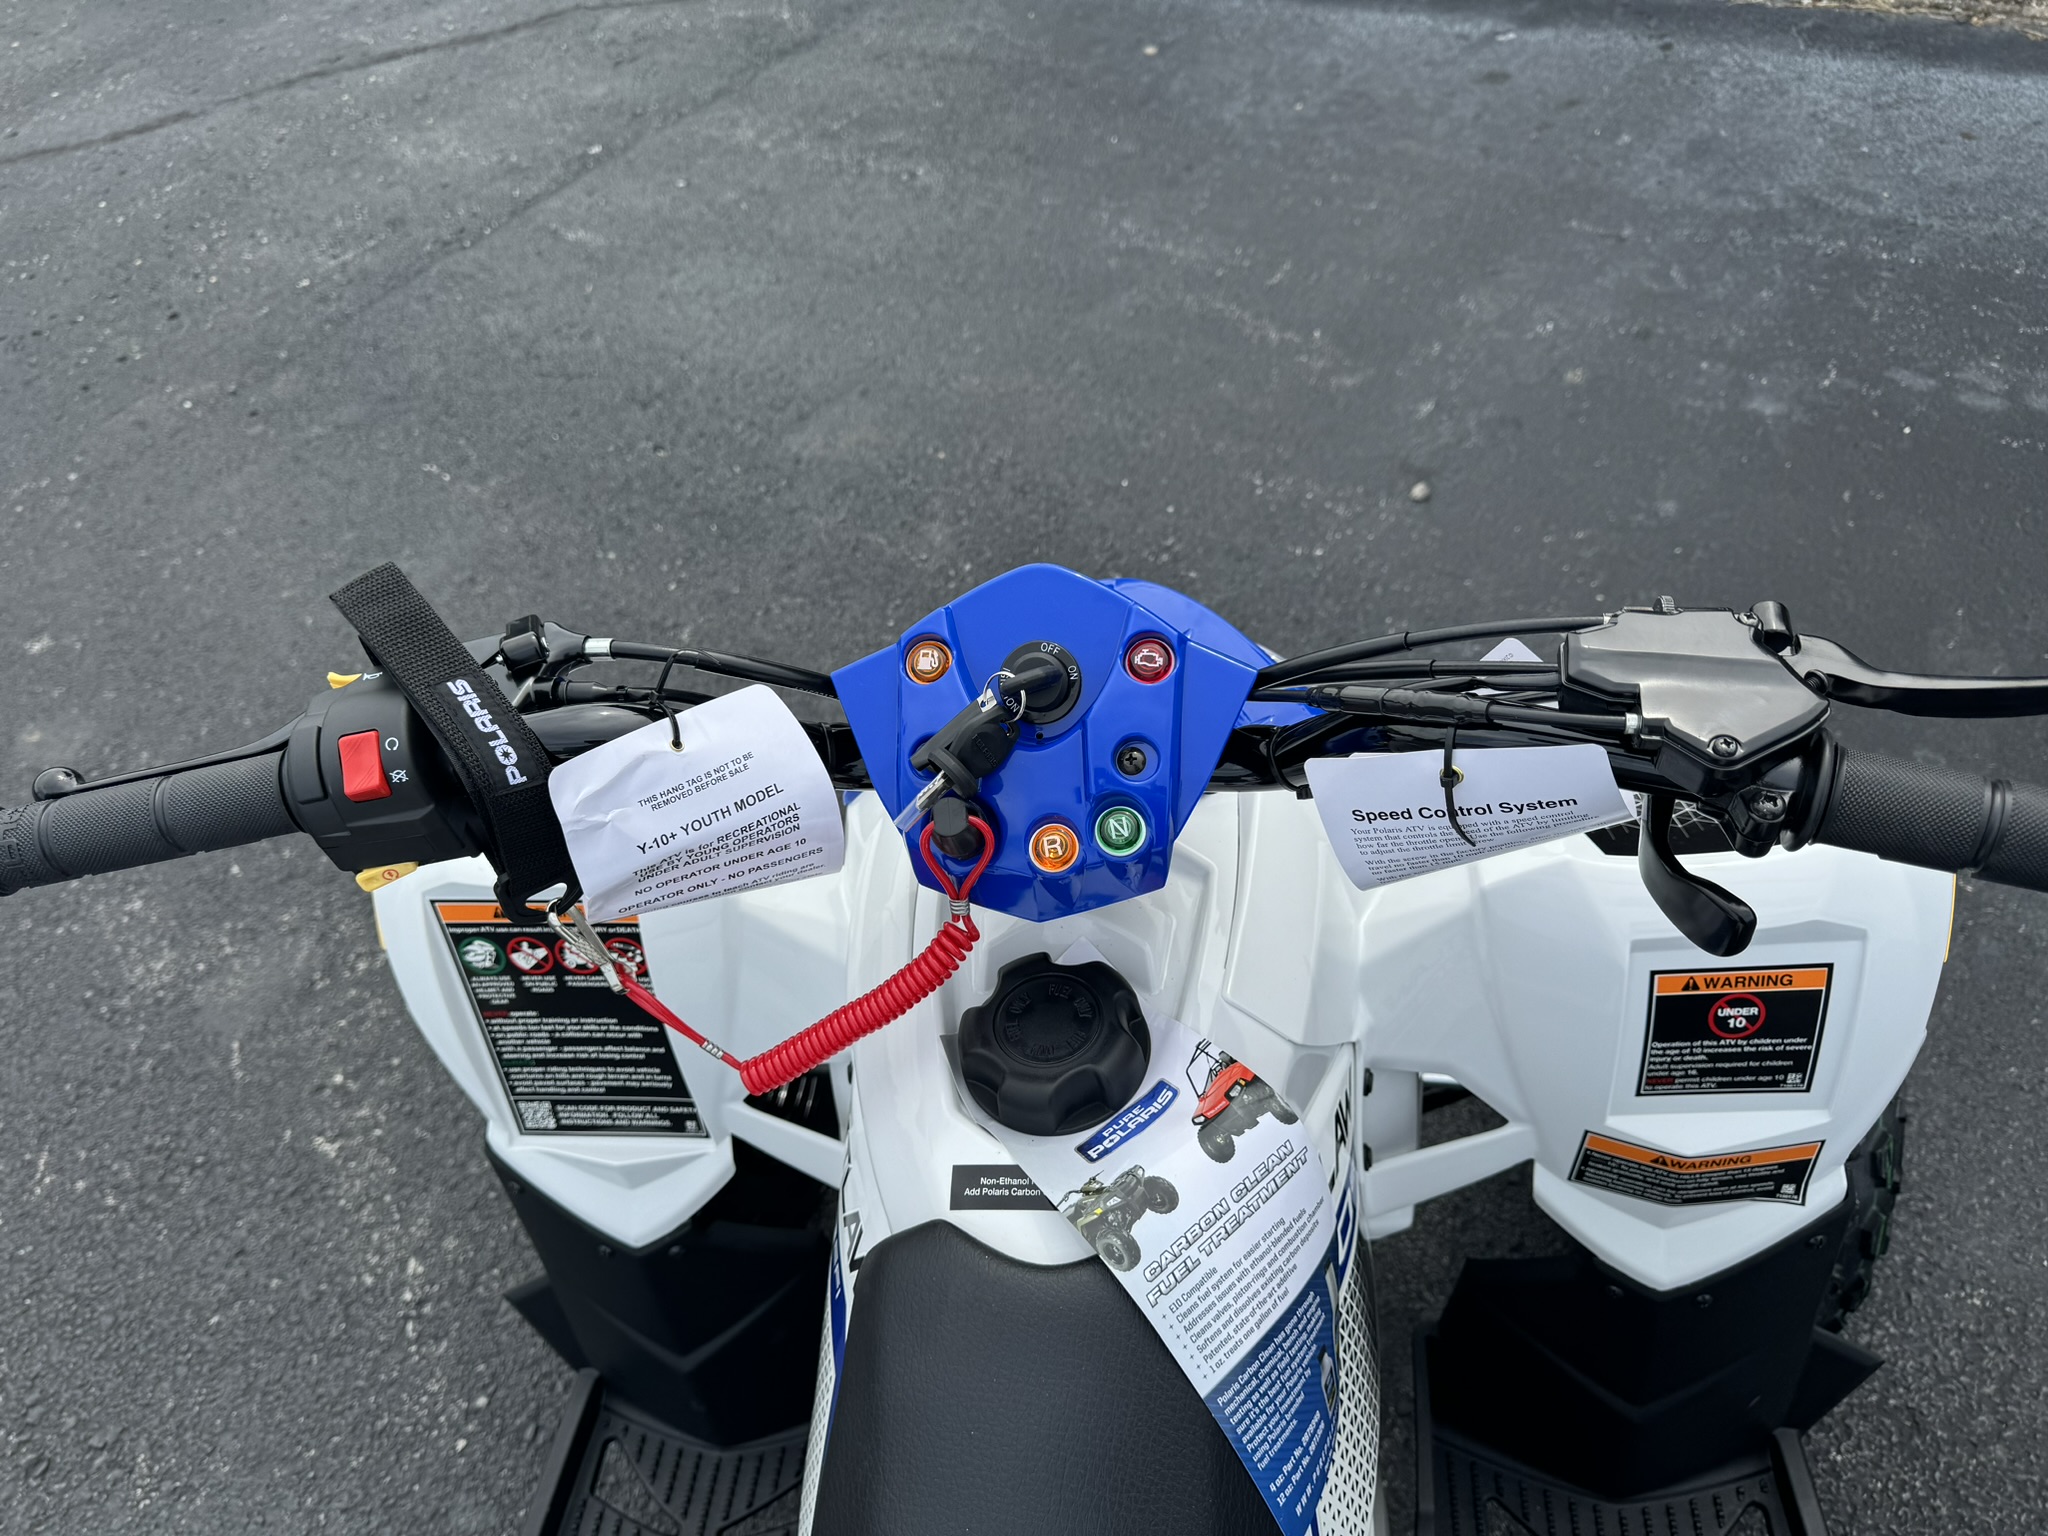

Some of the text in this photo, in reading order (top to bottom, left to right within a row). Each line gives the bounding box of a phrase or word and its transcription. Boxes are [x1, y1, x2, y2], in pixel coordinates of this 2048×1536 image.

[1040, 642, 1060, 655] OFF
[1068, 665, 1078, 680] ON
[447, 677, 527, 785] POLARIS
[637, 751, 754, 807] THIS HANG TAG IS NOT TO BE
[650, 762, 749, 812] REMOVED BEFORE SALE
[636, 781, 784, 855] Y-10+ YOUTH MODEL
[659, 851, 681, 864] ATV
[697, 840, 714, 850] for
[716, 801, 800, 844] RECREATIONAL
[1108, 816, 1129, 840] N
[1352, 808, 1413, 824] Speed
[1498, 798, 1578, 815] System
[1438, 822, 1478, 832] equped
[1480, 819, 1501, 827] with
[1511, 815, 1538, 824] speed
[1540, 810, 1573, 819] control
[637, 823, 800, 882] UNDER ADULT SUPERVISION
[666, 856, 683, 866] BY
[684, 841, 729, 861] YOUNG
[732, 813, 799, 845] OPERATORS
[1044, 835, 1062, 858] R
[618, 890, 684, 913] OPERATOR
[687, 878, 718, 892] ONLY
[727, 870, 745, 880] NO
[747, 846, 823, 874] PASSENGERS
[634, 837, 806, 895] NO OPERATOR UNDER AGE 10
[1703, 973, 1793, 988] WARNING
[1716, 1006, 1759, 1016] UNDER
[1727, 1016, 1746, 1028] 10
[1086, 1086, 1175, 1159] POLARIS
[1101, 1103, 1144, 1138] PURE
[980, 1176, 1029, 1184] Non-Ethanol
[1670, 1156, 1752, 1172] WARNING
[963, 1187, 1040, 1195] Add Polaris Carbon
[1140, 1197, 1233, 1283] CARBON
[1228, 1138, 1297, 1204] CLEAN
[1143, 1145, 1314, 1308] FUEL TREATMENT
[1167, 1264, 1219, 1314] E10 Compatible
[1174, 1216, 1286, 1324] Cleans fuel system for easier starting
[1181, 1206, 1308, 1334] Addresses issues with ethanol-blended fuels
[1188, 1195, 1326, 1344] Cleans valves, piston-rings and combustion chamber
[1195, 1218, 1321, 1354] Softens and dissolves existing carbon deposits
[1201, 1262, 1298, 1364] Patented, state-of-the-art additive
[1213, 1357, 1225, 1369] oz.
[1222, 1336, 1244, 1359] treats
[1241, 1325, 1255, 1340] one
[1251, 1305, 1273, 1330] gallon
[1269, 1298, 1279, 1310] of
[1275, 1286, 1290, 1302] fuel
[1215, 1380, 1241, 1406] Polaris
[1236, 1358, 1261, 1384] Carbon
[1256, 1341, 1277, 1362] Clean
[1228, 1398, 1254, 1425] testing
[1244, 1410, 1282, 1453] Protect your
[1250, 1417, 1288, 1462] using Polaris
[1255, 1454, 1271, 1470] fuel
